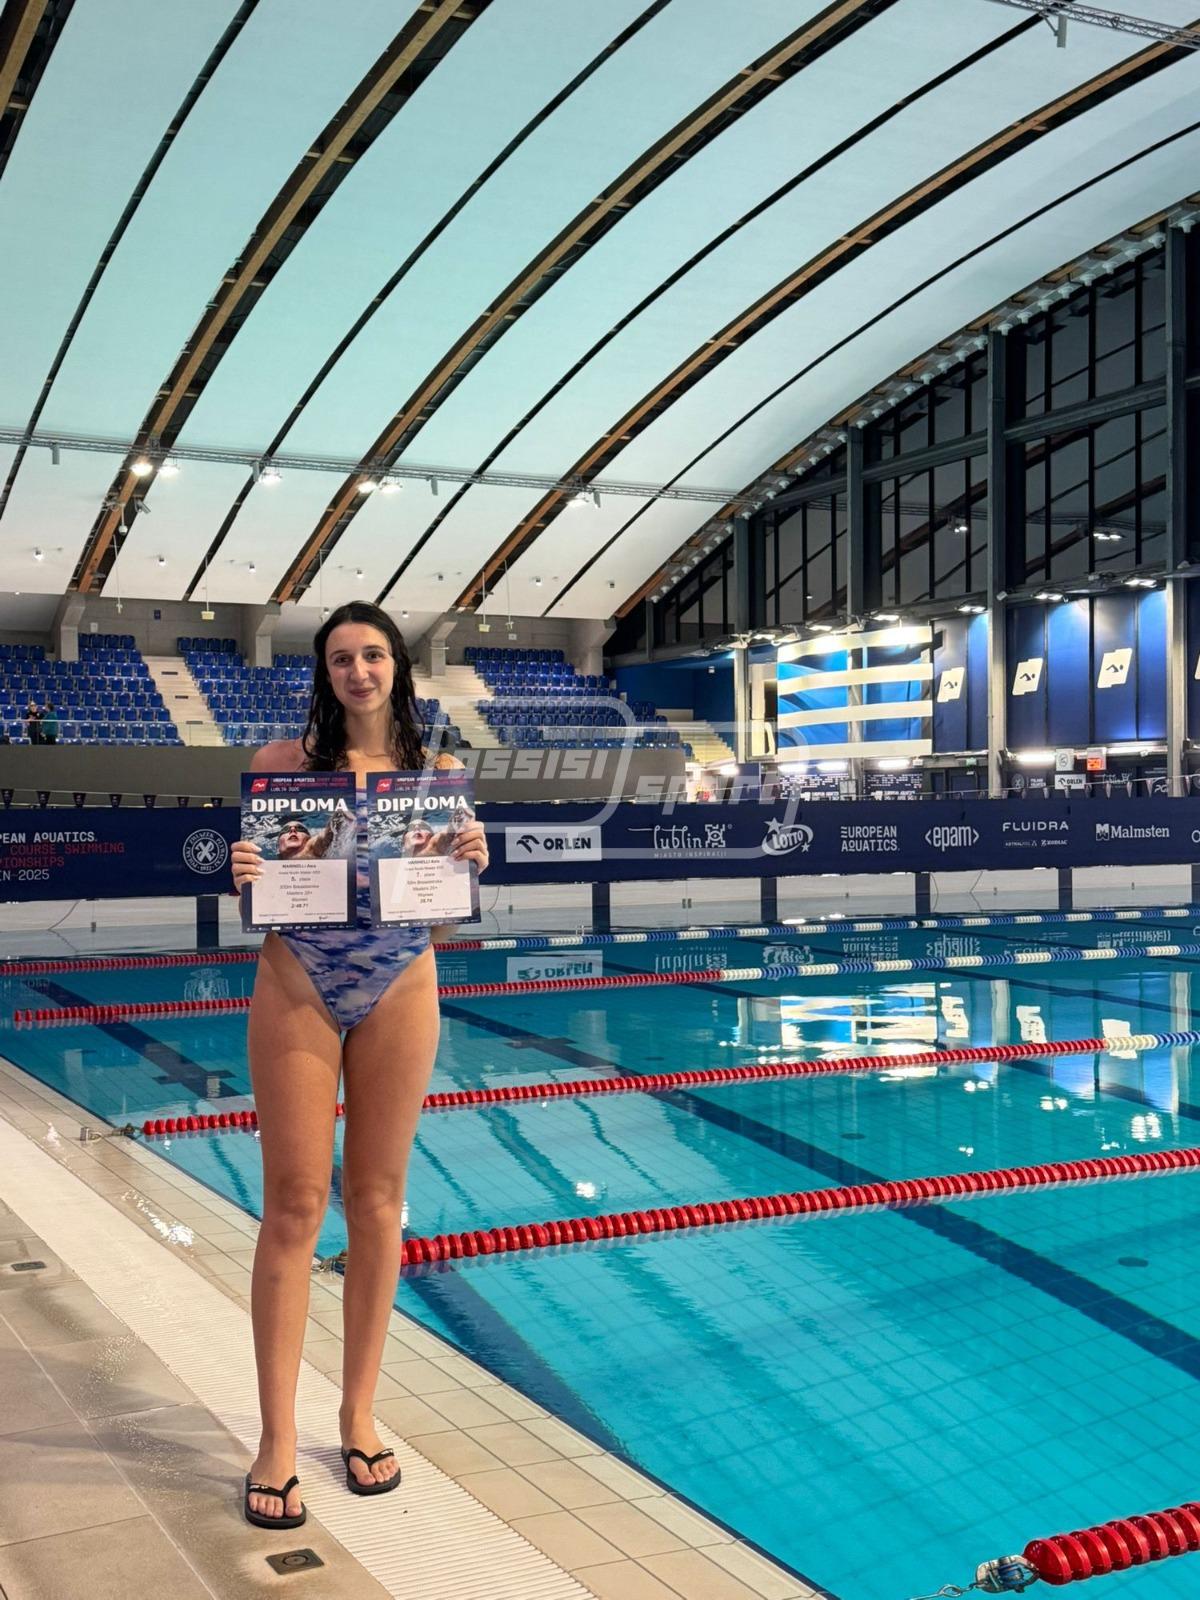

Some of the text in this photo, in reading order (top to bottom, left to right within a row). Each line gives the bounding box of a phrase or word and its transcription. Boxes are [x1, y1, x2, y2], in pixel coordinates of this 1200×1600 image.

[251, 798, 349, 813] DIPLOMA
[377, 795, 468, 812] DIPLOMA
[840, 826, 897, 839] EUROPEAN
[1002, 821, 1070, 832] FLUIDRA
[1110, 825, 1170, 839] Malmsten
[543, 837, 591, 850] ORLEN
[771, 830, 804, 849] LOTTO
[10, 843, 125, 855] COURSE SWIMMING
[18, 869, 50, 880] 2025
